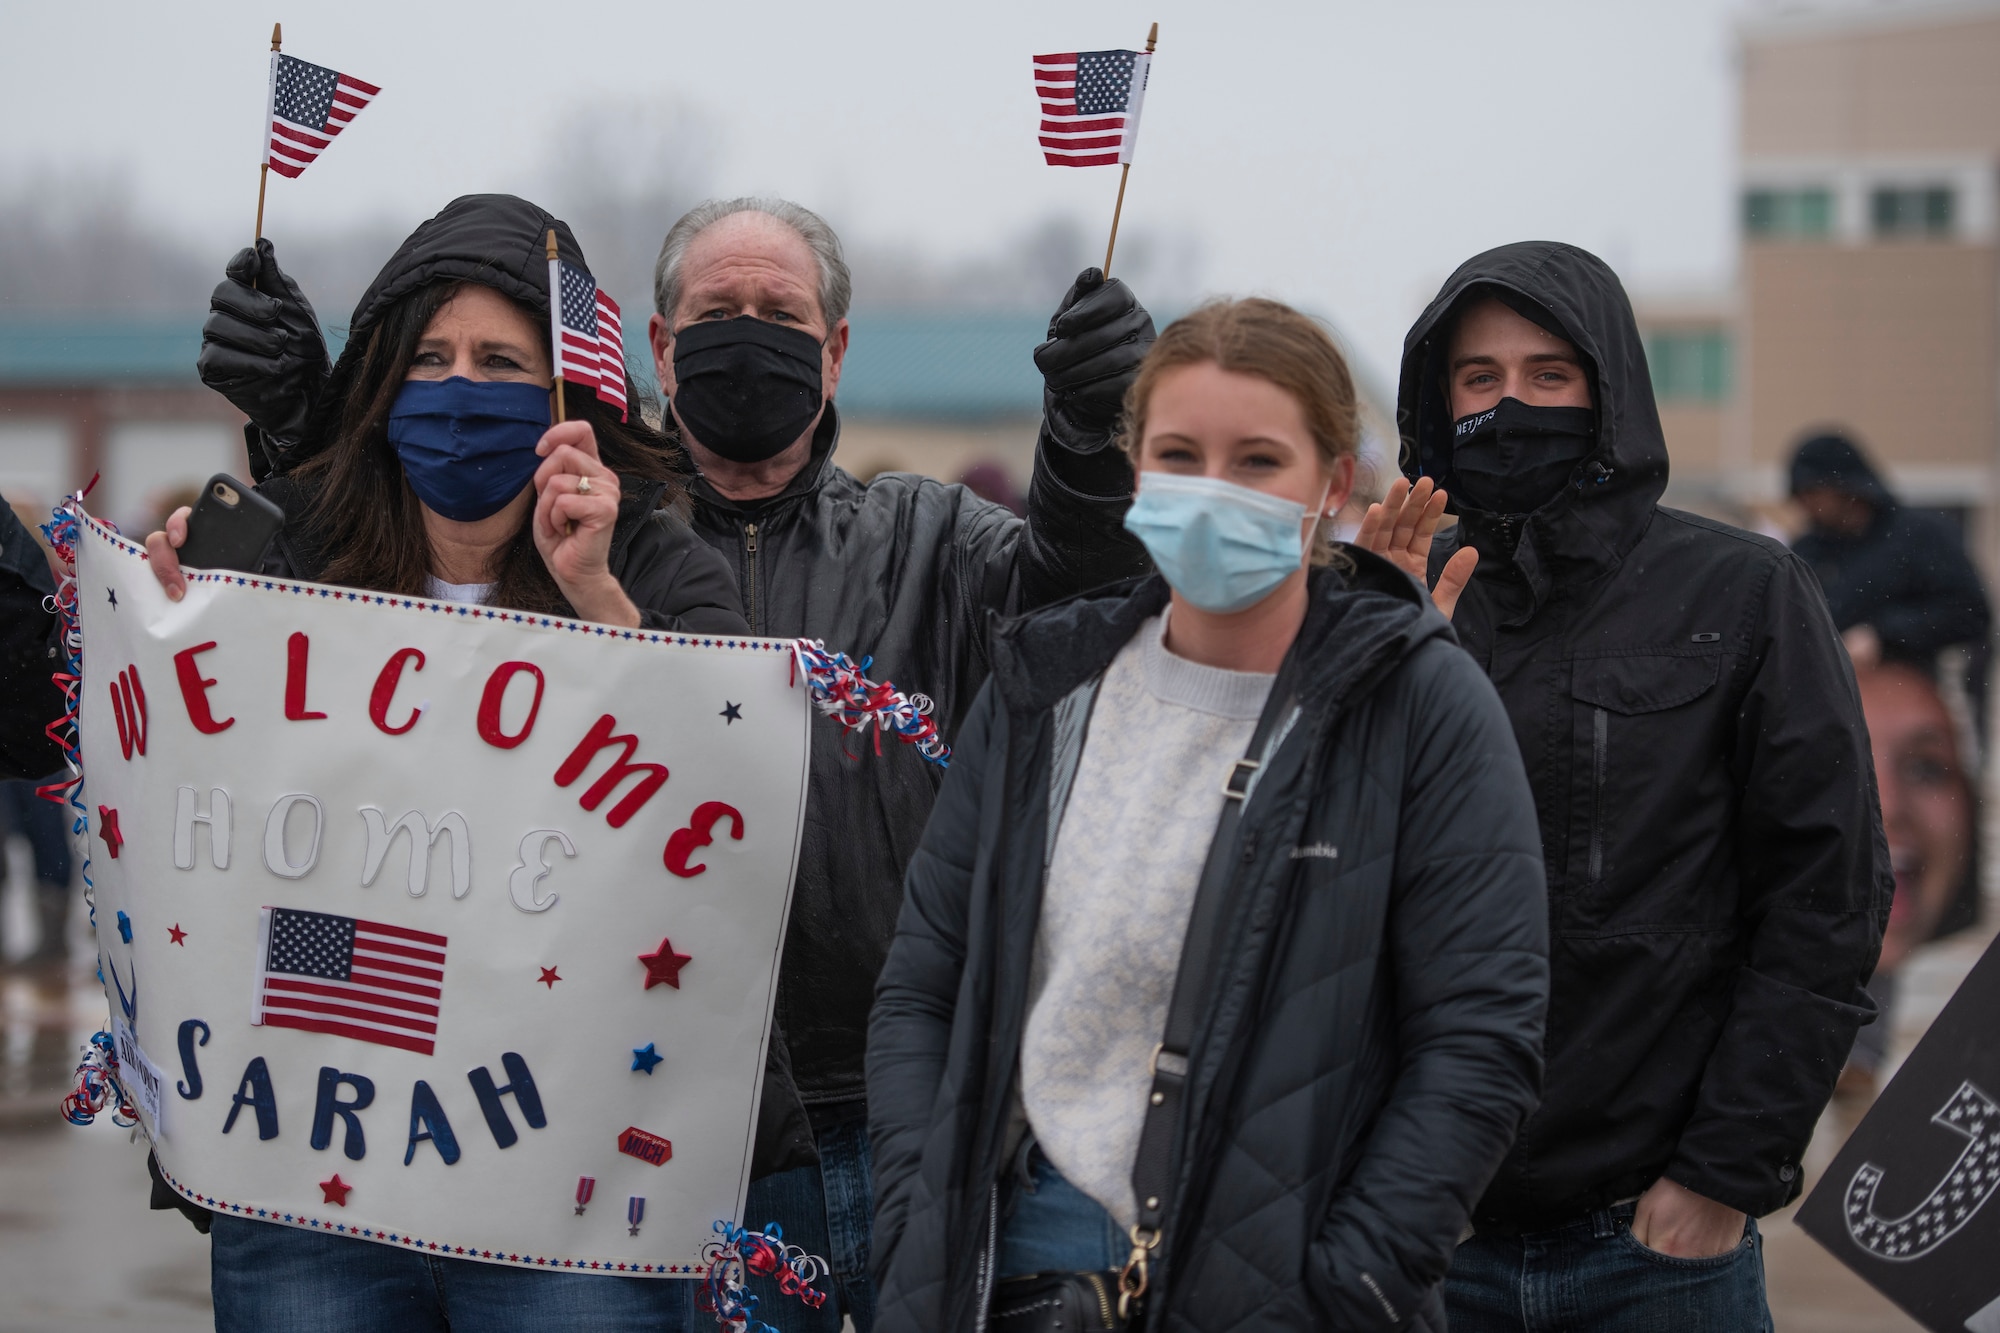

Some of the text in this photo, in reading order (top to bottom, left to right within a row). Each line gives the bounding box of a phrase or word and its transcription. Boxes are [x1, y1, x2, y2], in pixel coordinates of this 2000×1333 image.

[1455, 409, 1497, 436] NETJETS
[109, 630, 745, 878] WELCOME
[172, 785, 578, 914] HOME
[120, 1036, 137, 1072] AIR
[176, 1018, 548, 1167] SARAH
[623, 1135, 665, 1164] MUCH
[631, 1130, 669, 1148] miss you
